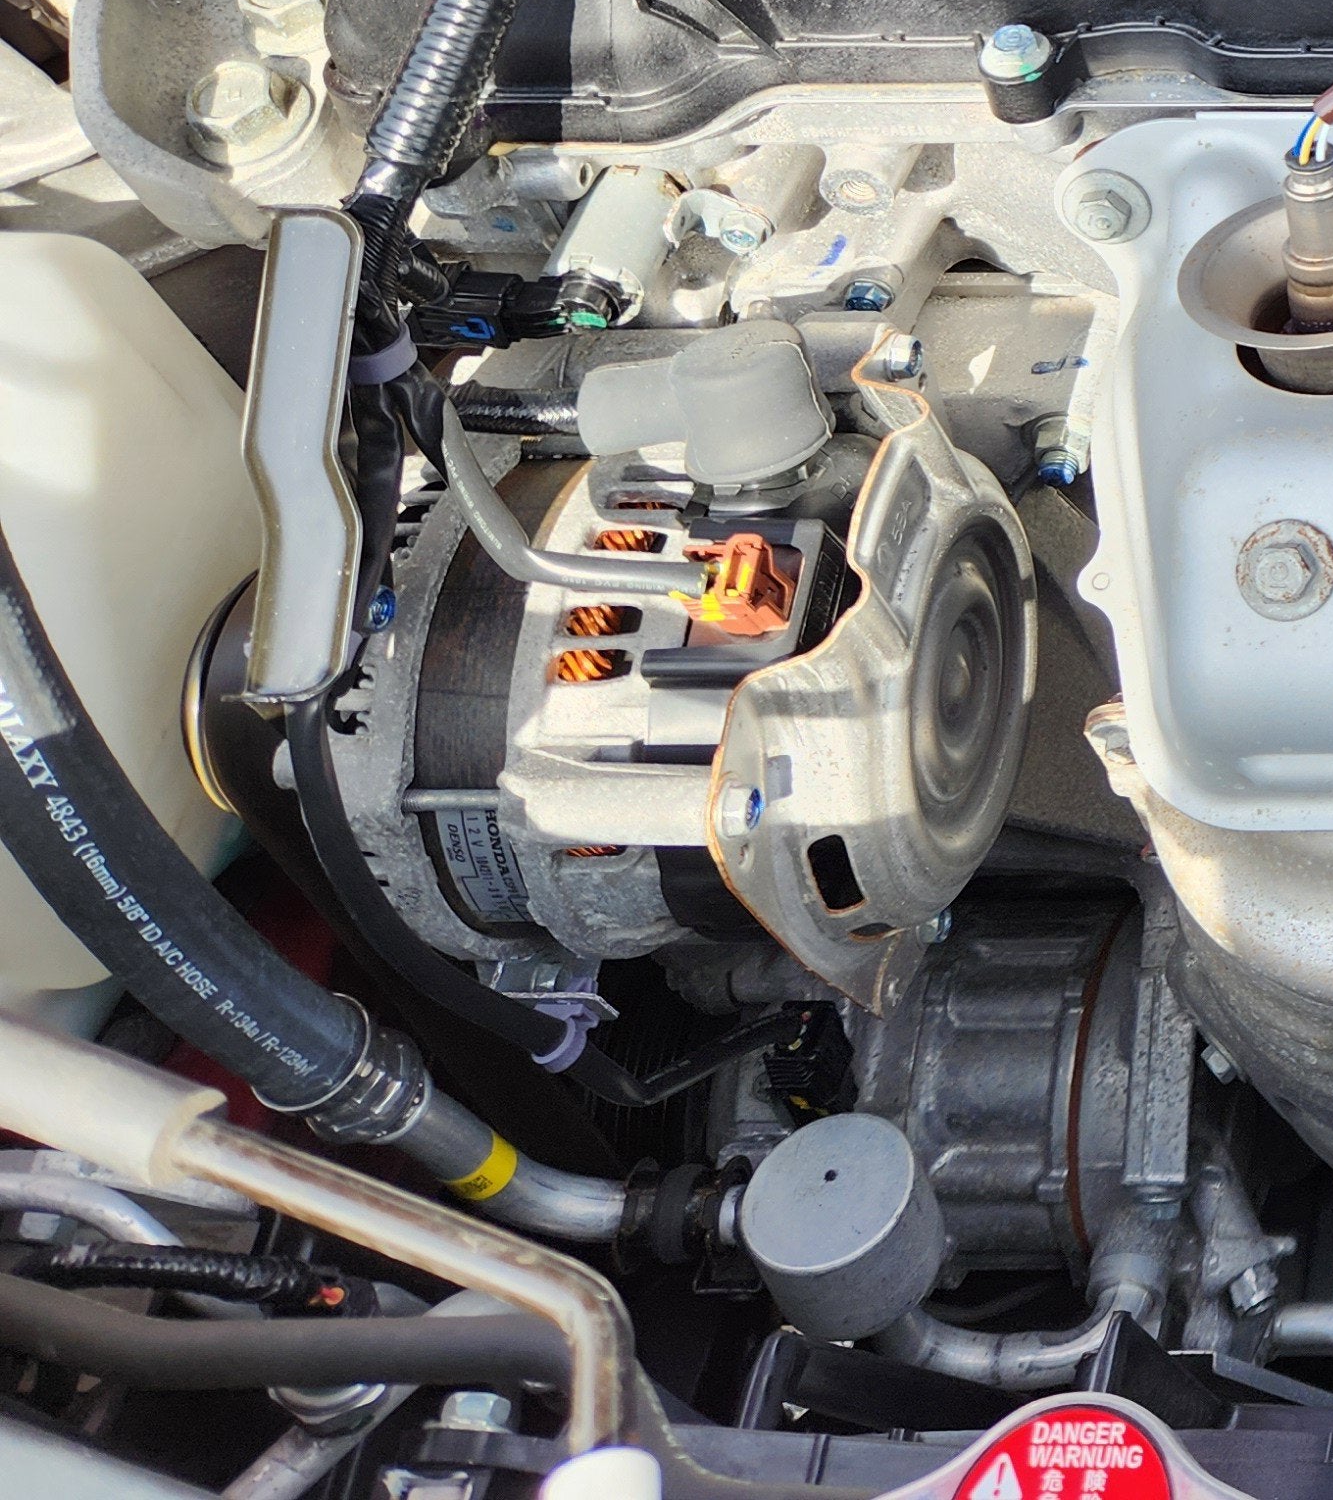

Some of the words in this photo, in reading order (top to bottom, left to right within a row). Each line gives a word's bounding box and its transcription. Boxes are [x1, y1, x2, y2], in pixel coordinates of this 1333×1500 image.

[0, 678, 59, 789] ALAXY
[46, 796, 88, 842] 4843
[73, 842, 128, 900] (16mm)
[117, 895, 150, 923] 5/8"
[139, 922, 163, 942] ID
[153, 940, 184, 966] A/C
[175, 962, 219, 1000] HOSE
[215, 999, 260, 1038] R-134a
[447, 823, 466, 863] DENSO
[485, 809, 510, 877] HONDA
[1031, 1421, 1127, 1445] DANGER
[1029, 1445, 1144, 1469] WARNUNG
